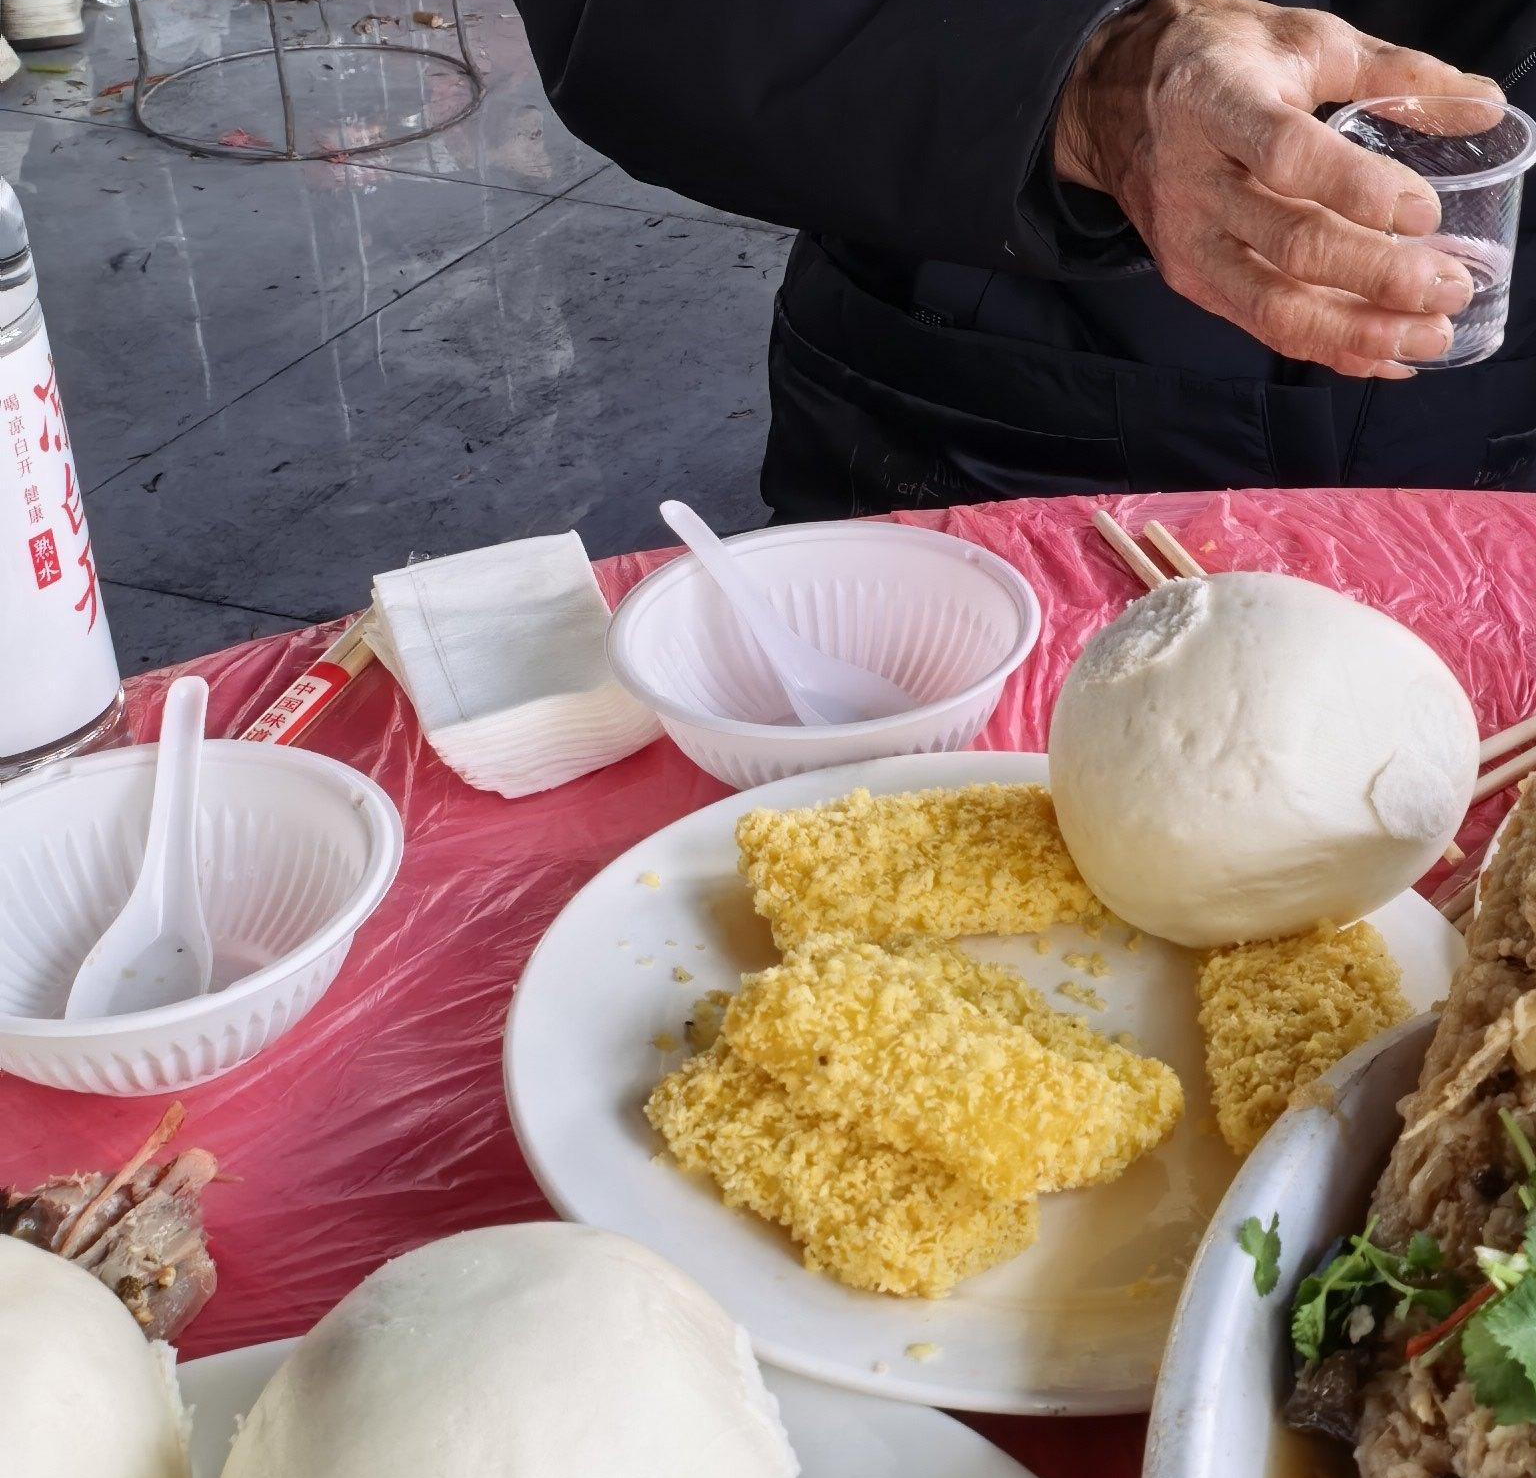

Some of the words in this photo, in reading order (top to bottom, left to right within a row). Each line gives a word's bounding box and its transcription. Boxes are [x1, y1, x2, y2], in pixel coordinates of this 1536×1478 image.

[3, 393, 33, 479] 喝凉白开
[23, 484, 45, 526] 健康
[33, 537, 60, 582] 熟水
[241, 682, 317, 743] 中国味道
